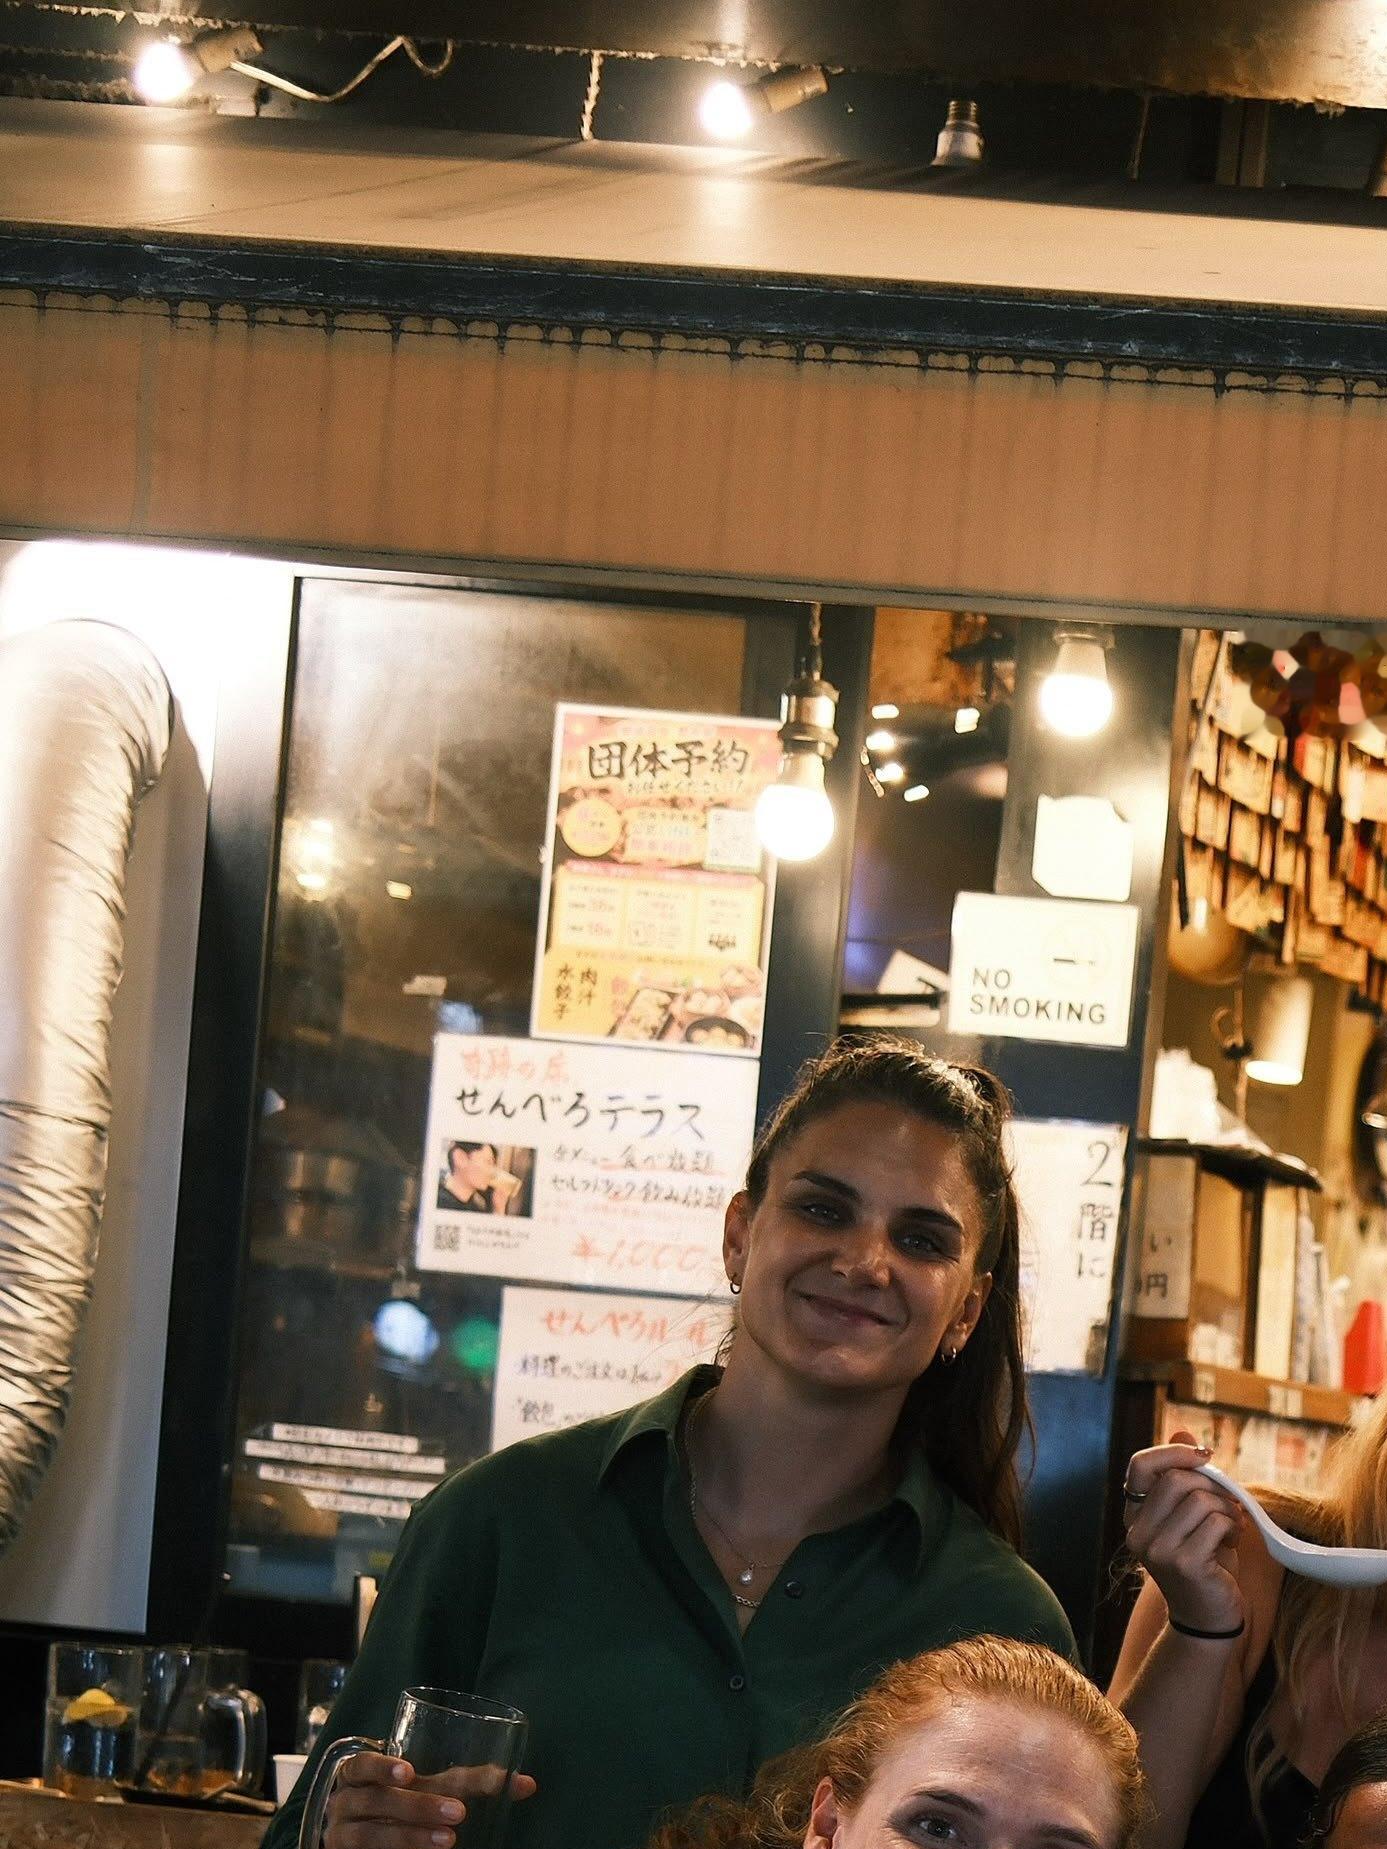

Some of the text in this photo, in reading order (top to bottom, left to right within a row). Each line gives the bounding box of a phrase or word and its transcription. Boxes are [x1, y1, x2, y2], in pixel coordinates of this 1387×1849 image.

[588, 739, 750, 780] 団体予約
[972, 967, 1012, 990] NO
[970, 993, 1106, 1025] SMOKING
[455, 1086, 706, 1141] せんべろテラス
